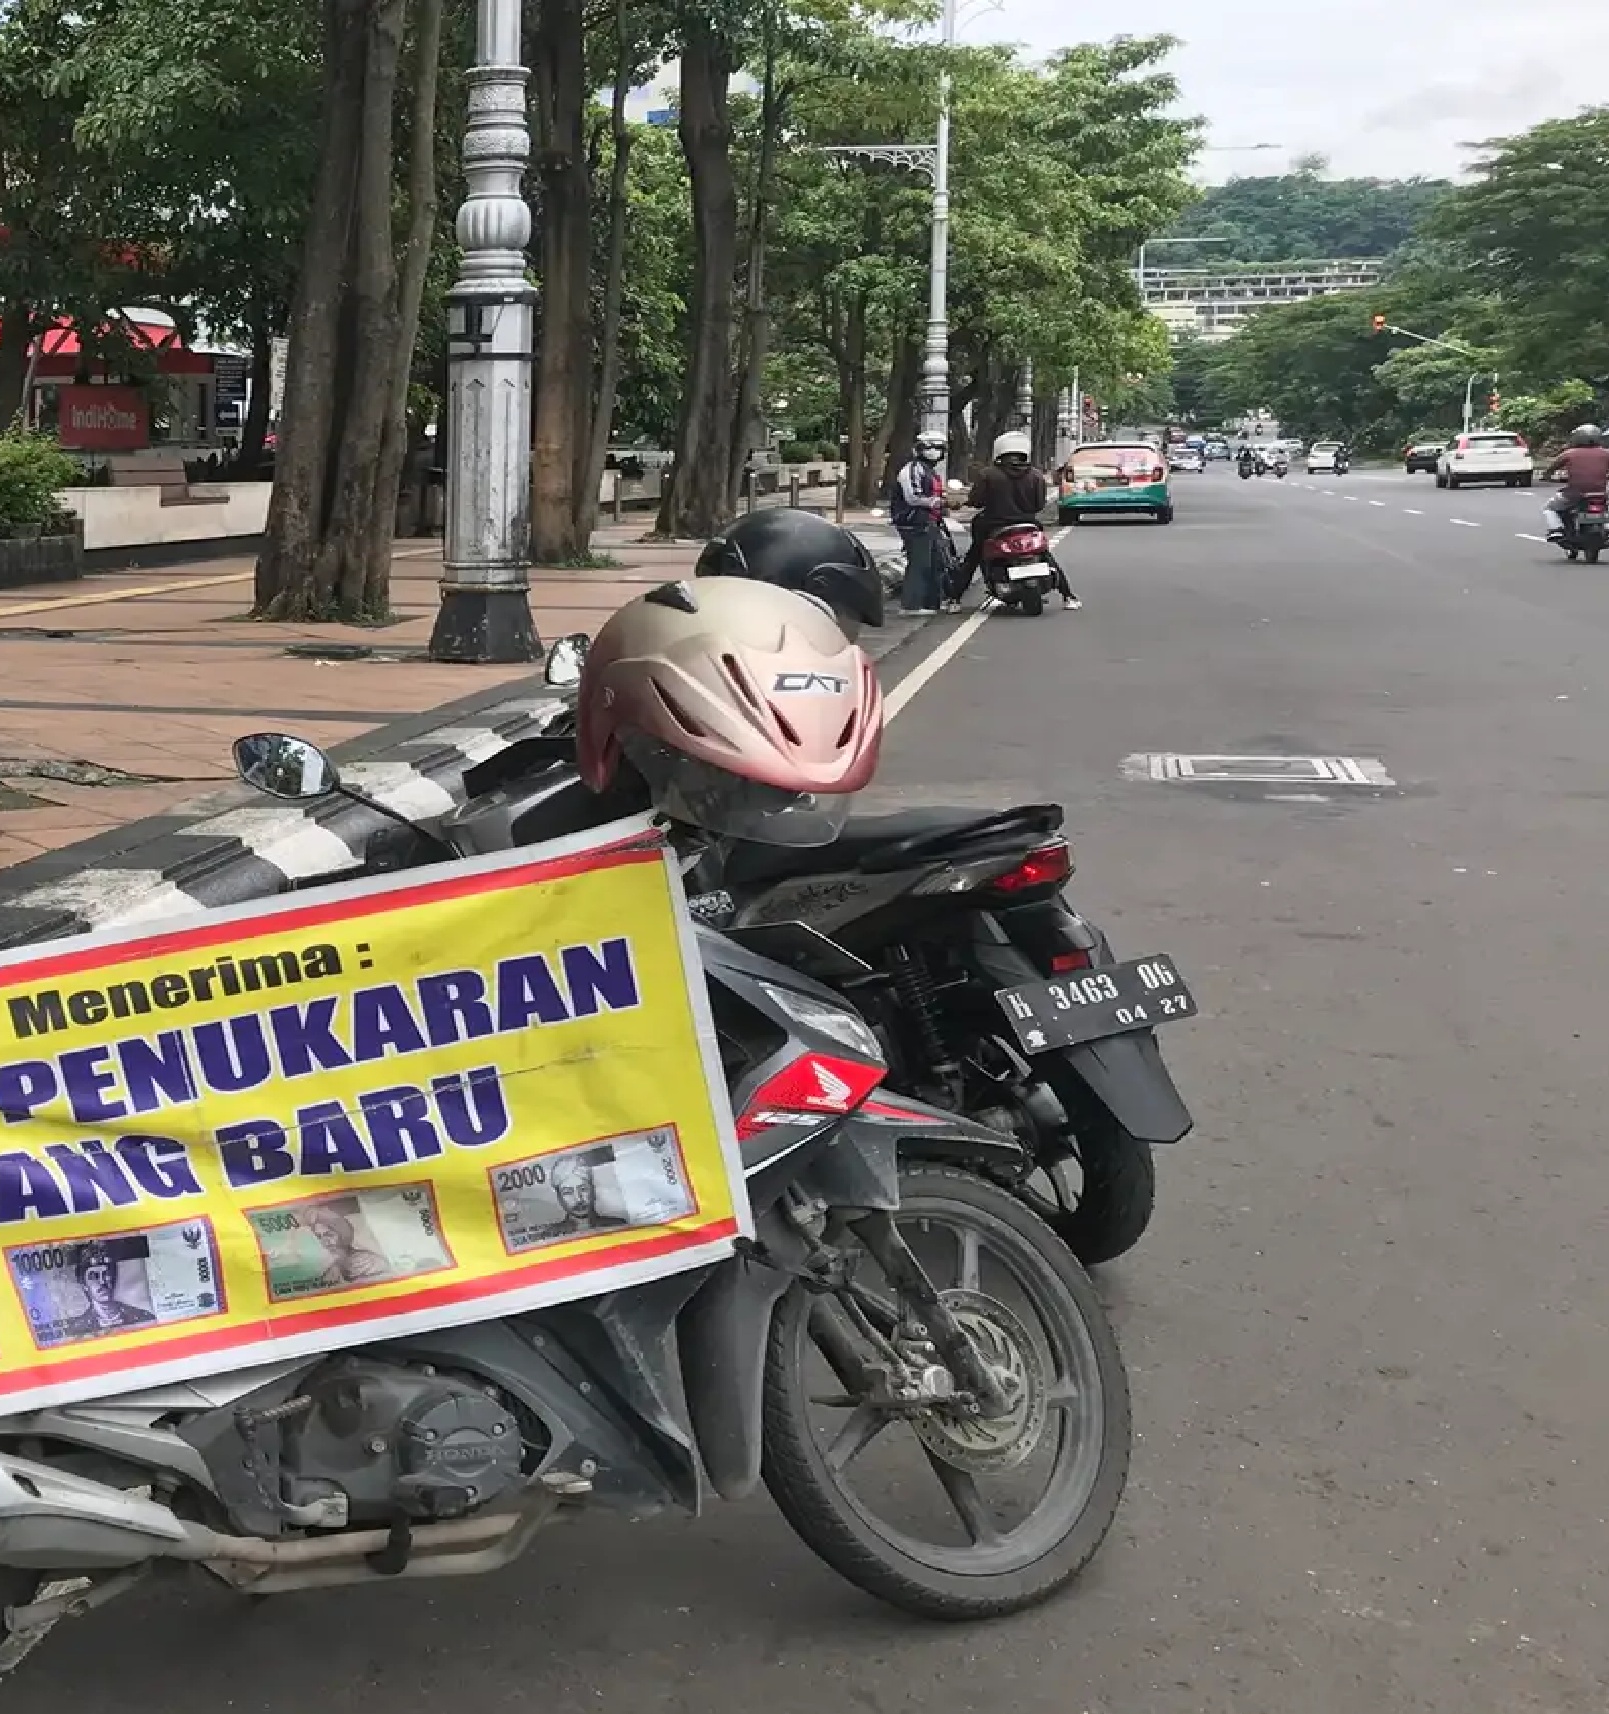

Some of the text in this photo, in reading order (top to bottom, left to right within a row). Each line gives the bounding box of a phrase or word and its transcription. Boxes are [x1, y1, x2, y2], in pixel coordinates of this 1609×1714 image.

[7, 942, 343, 1039] Menerima
[1048, 974, 1119, 1010] 3463
[1115, 994, 1187, 1025] 04 27
[212, 1066, 509, 1188] BARU
[497, 1163, 546, 1193] 2000
[258, 1212, 300, 1234] 5000
[11, 1247, 65, 1272] 10000
